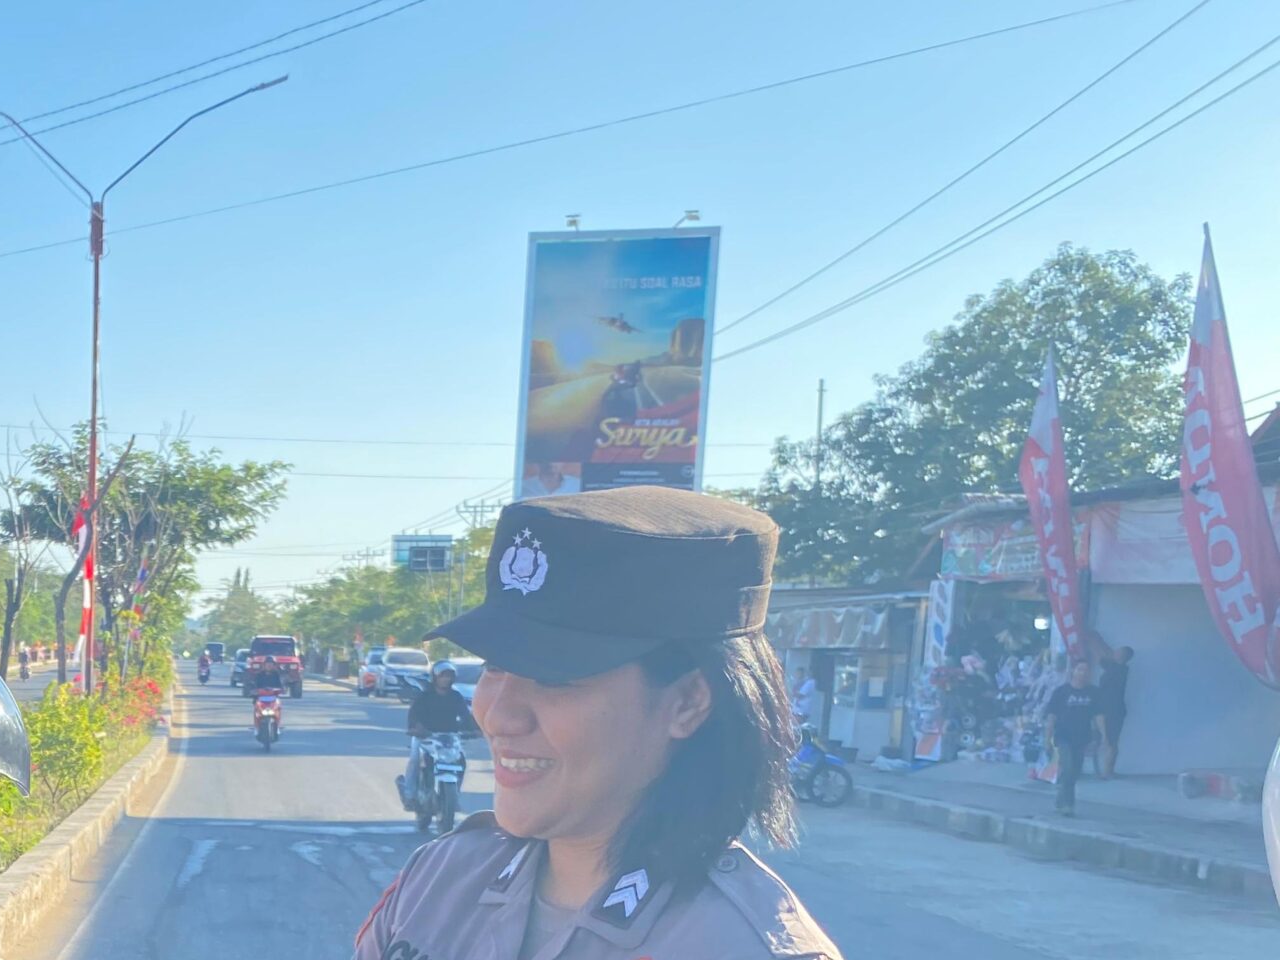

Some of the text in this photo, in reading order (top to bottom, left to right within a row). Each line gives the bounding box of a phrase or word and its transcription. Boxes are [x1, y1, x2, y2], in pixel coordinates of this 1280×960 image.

[640, 277, 669, 289] SOAL
[671, 276, 702, 288] RASA
[596, 417, 698, 460] Surya
